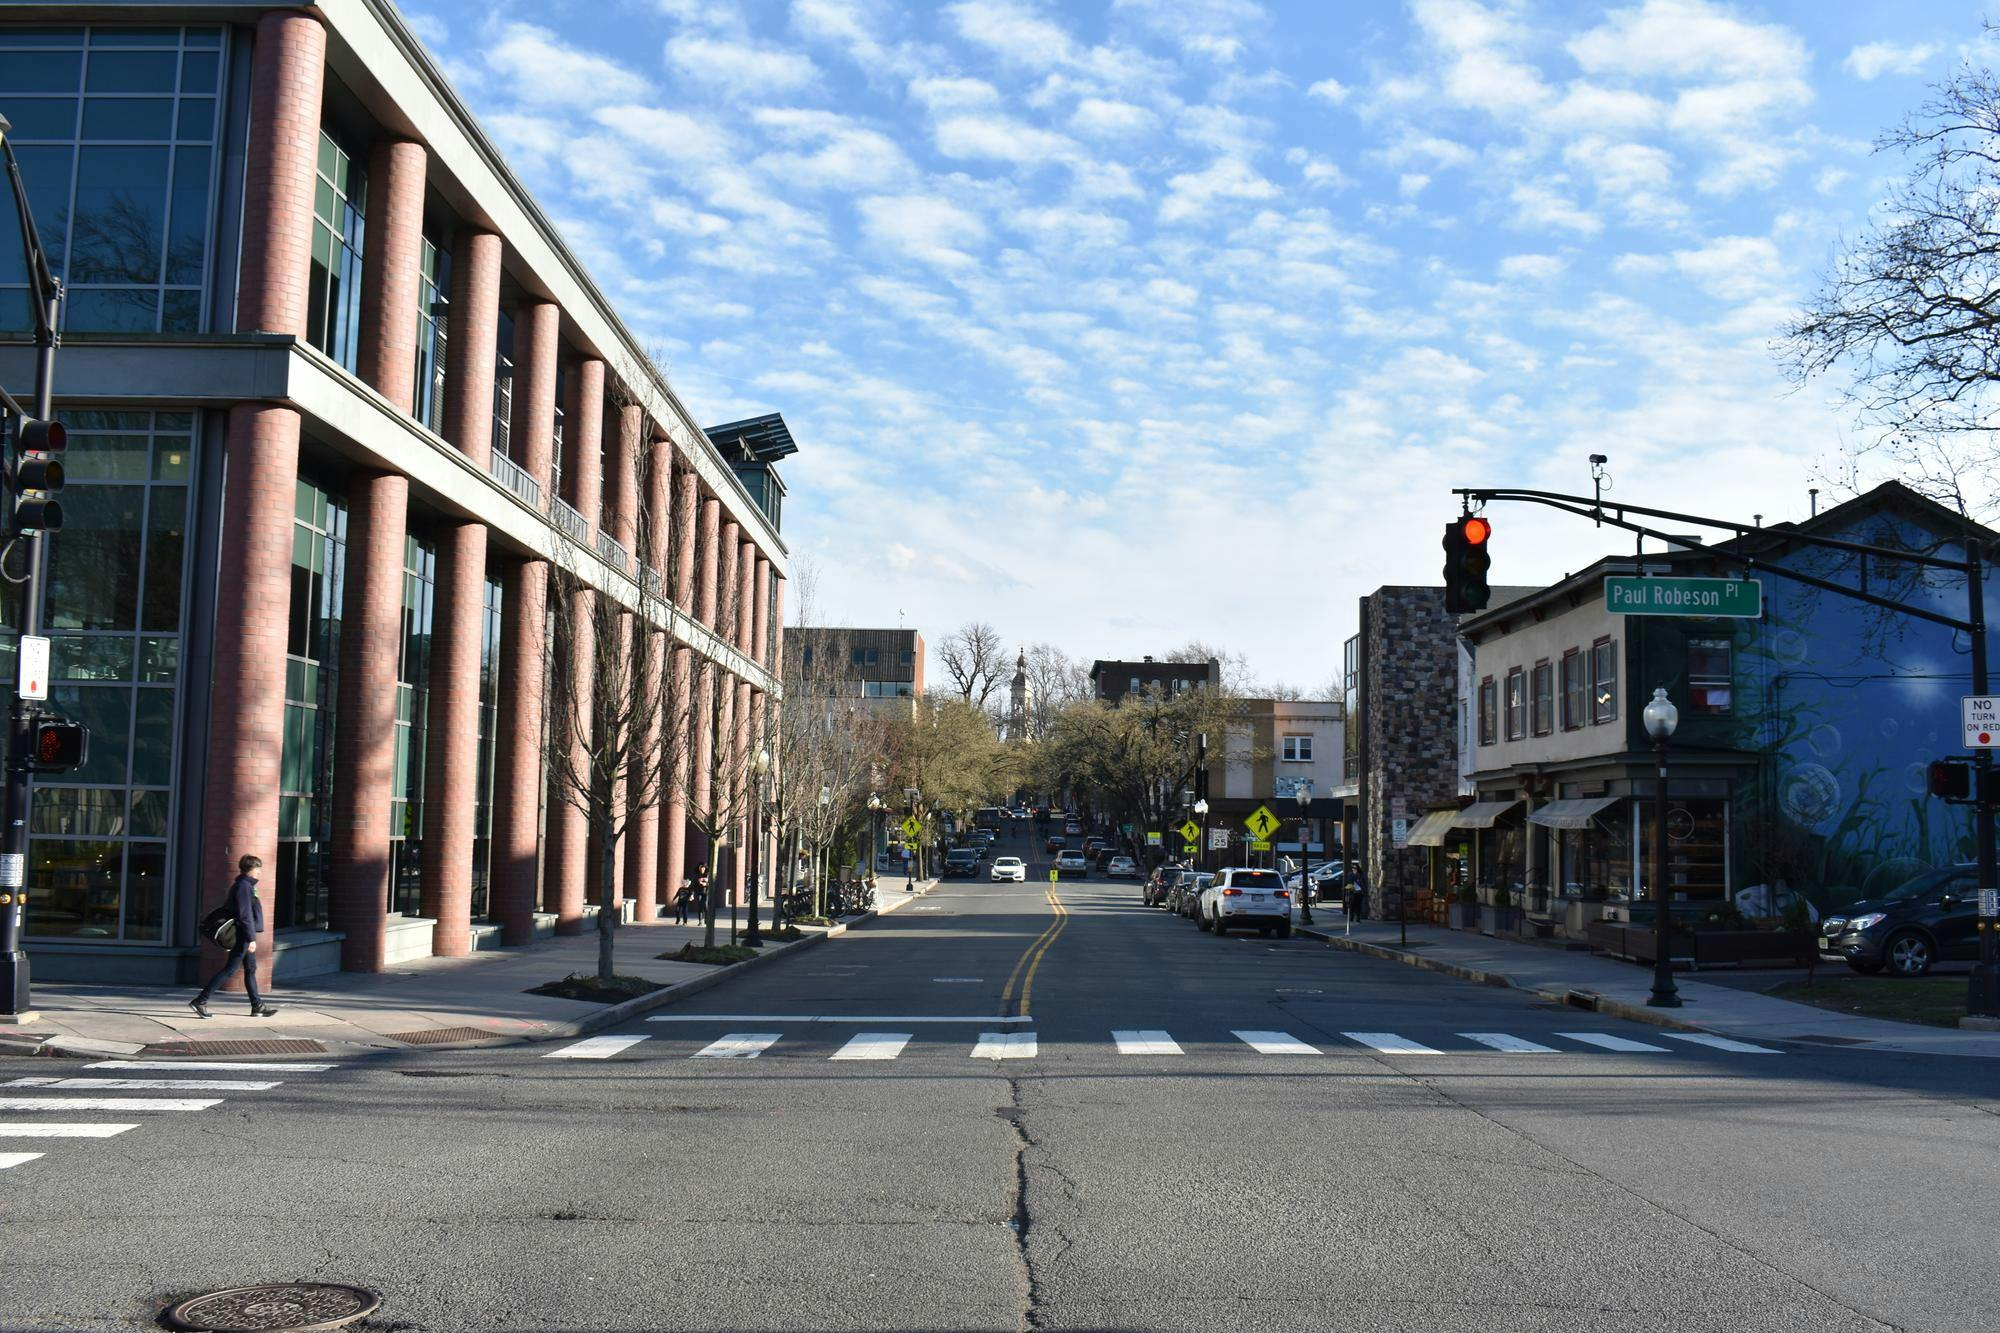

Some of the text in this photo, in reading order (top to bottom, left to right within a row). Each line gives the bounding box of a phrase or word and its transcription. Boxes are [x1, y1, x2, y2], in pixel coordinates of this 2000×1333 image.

[1614, 584, 1738, 606] Paul Robeson Pl
[1973, 700, 1992, 710] NO
